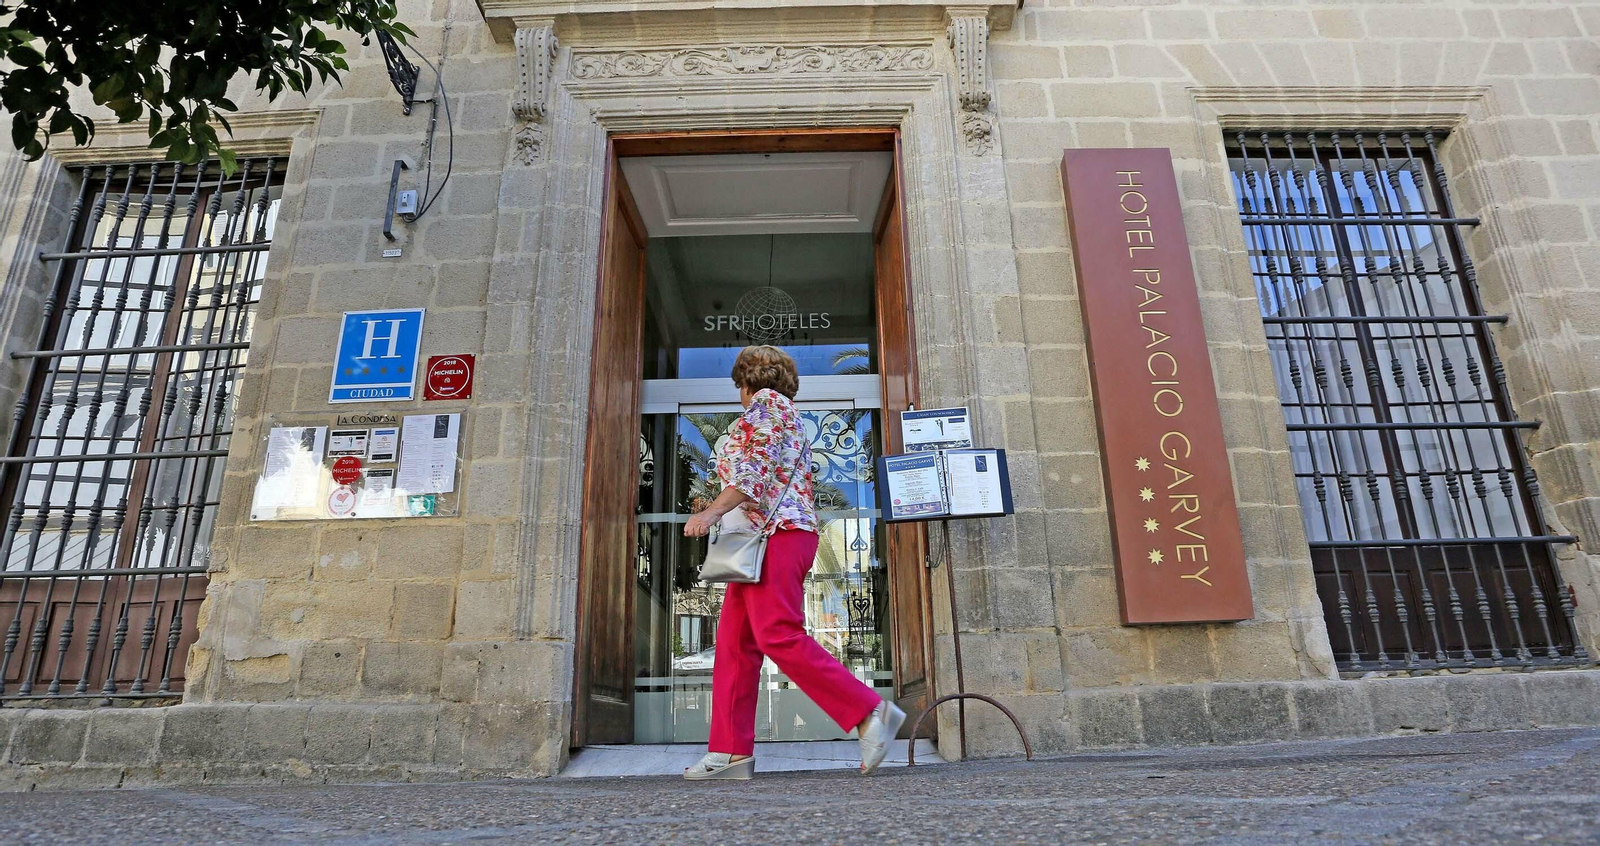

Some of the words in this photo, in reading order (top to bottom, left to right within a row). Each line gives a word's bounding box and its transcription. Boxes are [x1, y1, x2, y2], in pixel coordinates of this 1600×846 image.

[1116, 170, 1155, 258] HOTEL
[355, 319, 407, 359] H
[1132, 268, 1184, 417] PALACIO
[350, 388, 394, 398] CIUDAD
[1160, 431, 1212, 587] GARVEY
